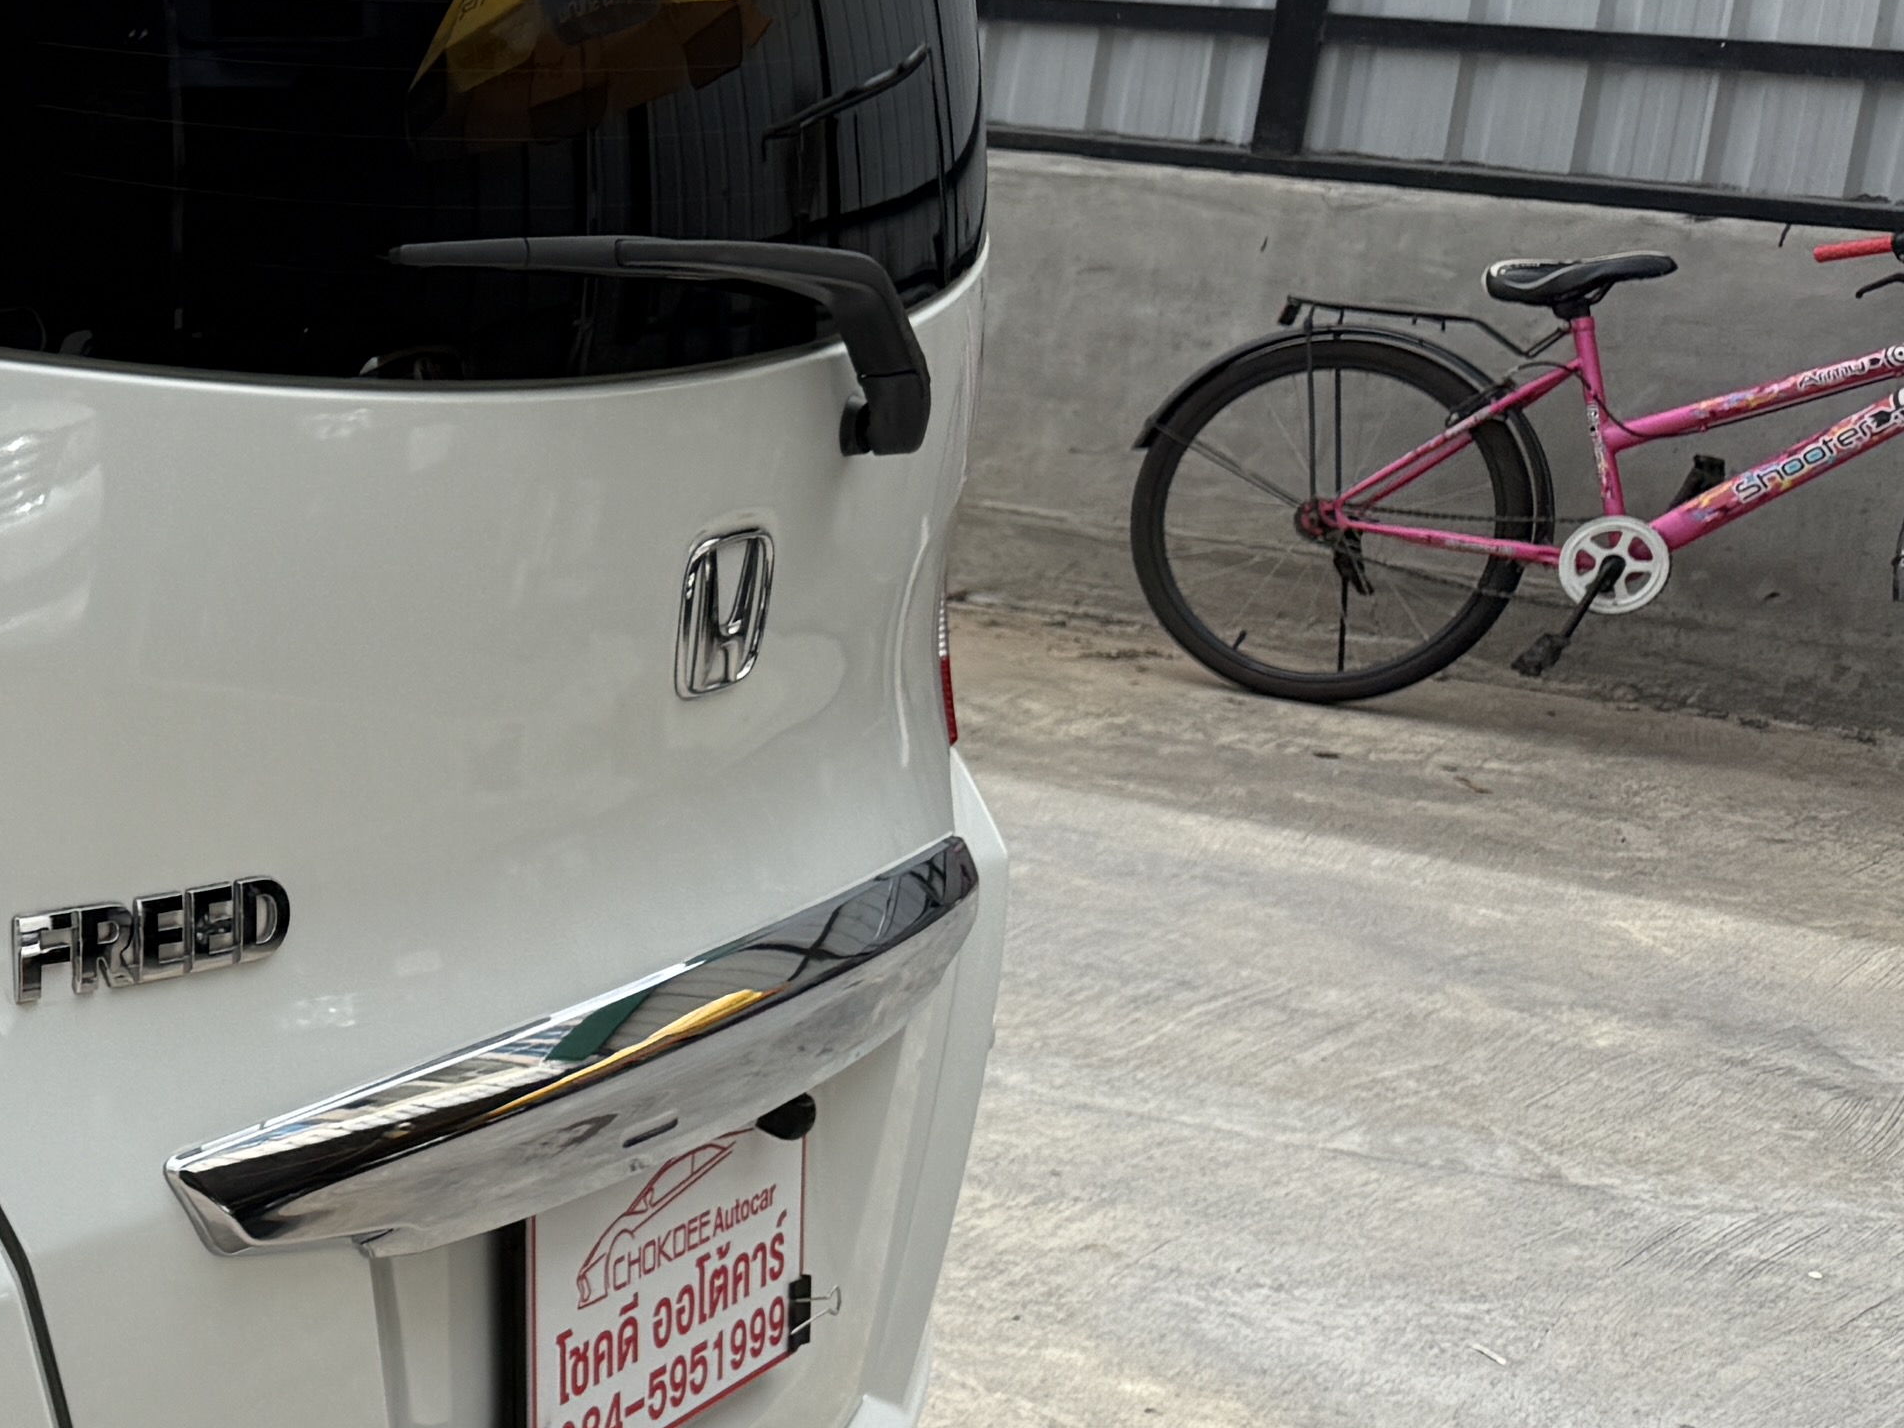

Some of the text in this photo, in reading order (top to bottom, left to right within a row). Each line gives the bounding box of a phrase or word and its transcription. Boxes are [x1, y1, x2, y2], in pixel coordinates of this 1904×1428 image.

[11, 875, 291, 1004] FREED
[612, 1183, 778, 1292] CHOKDEE Autocar
[556, 1209, 789, 1406] โชคดี ออโต้คาร์
